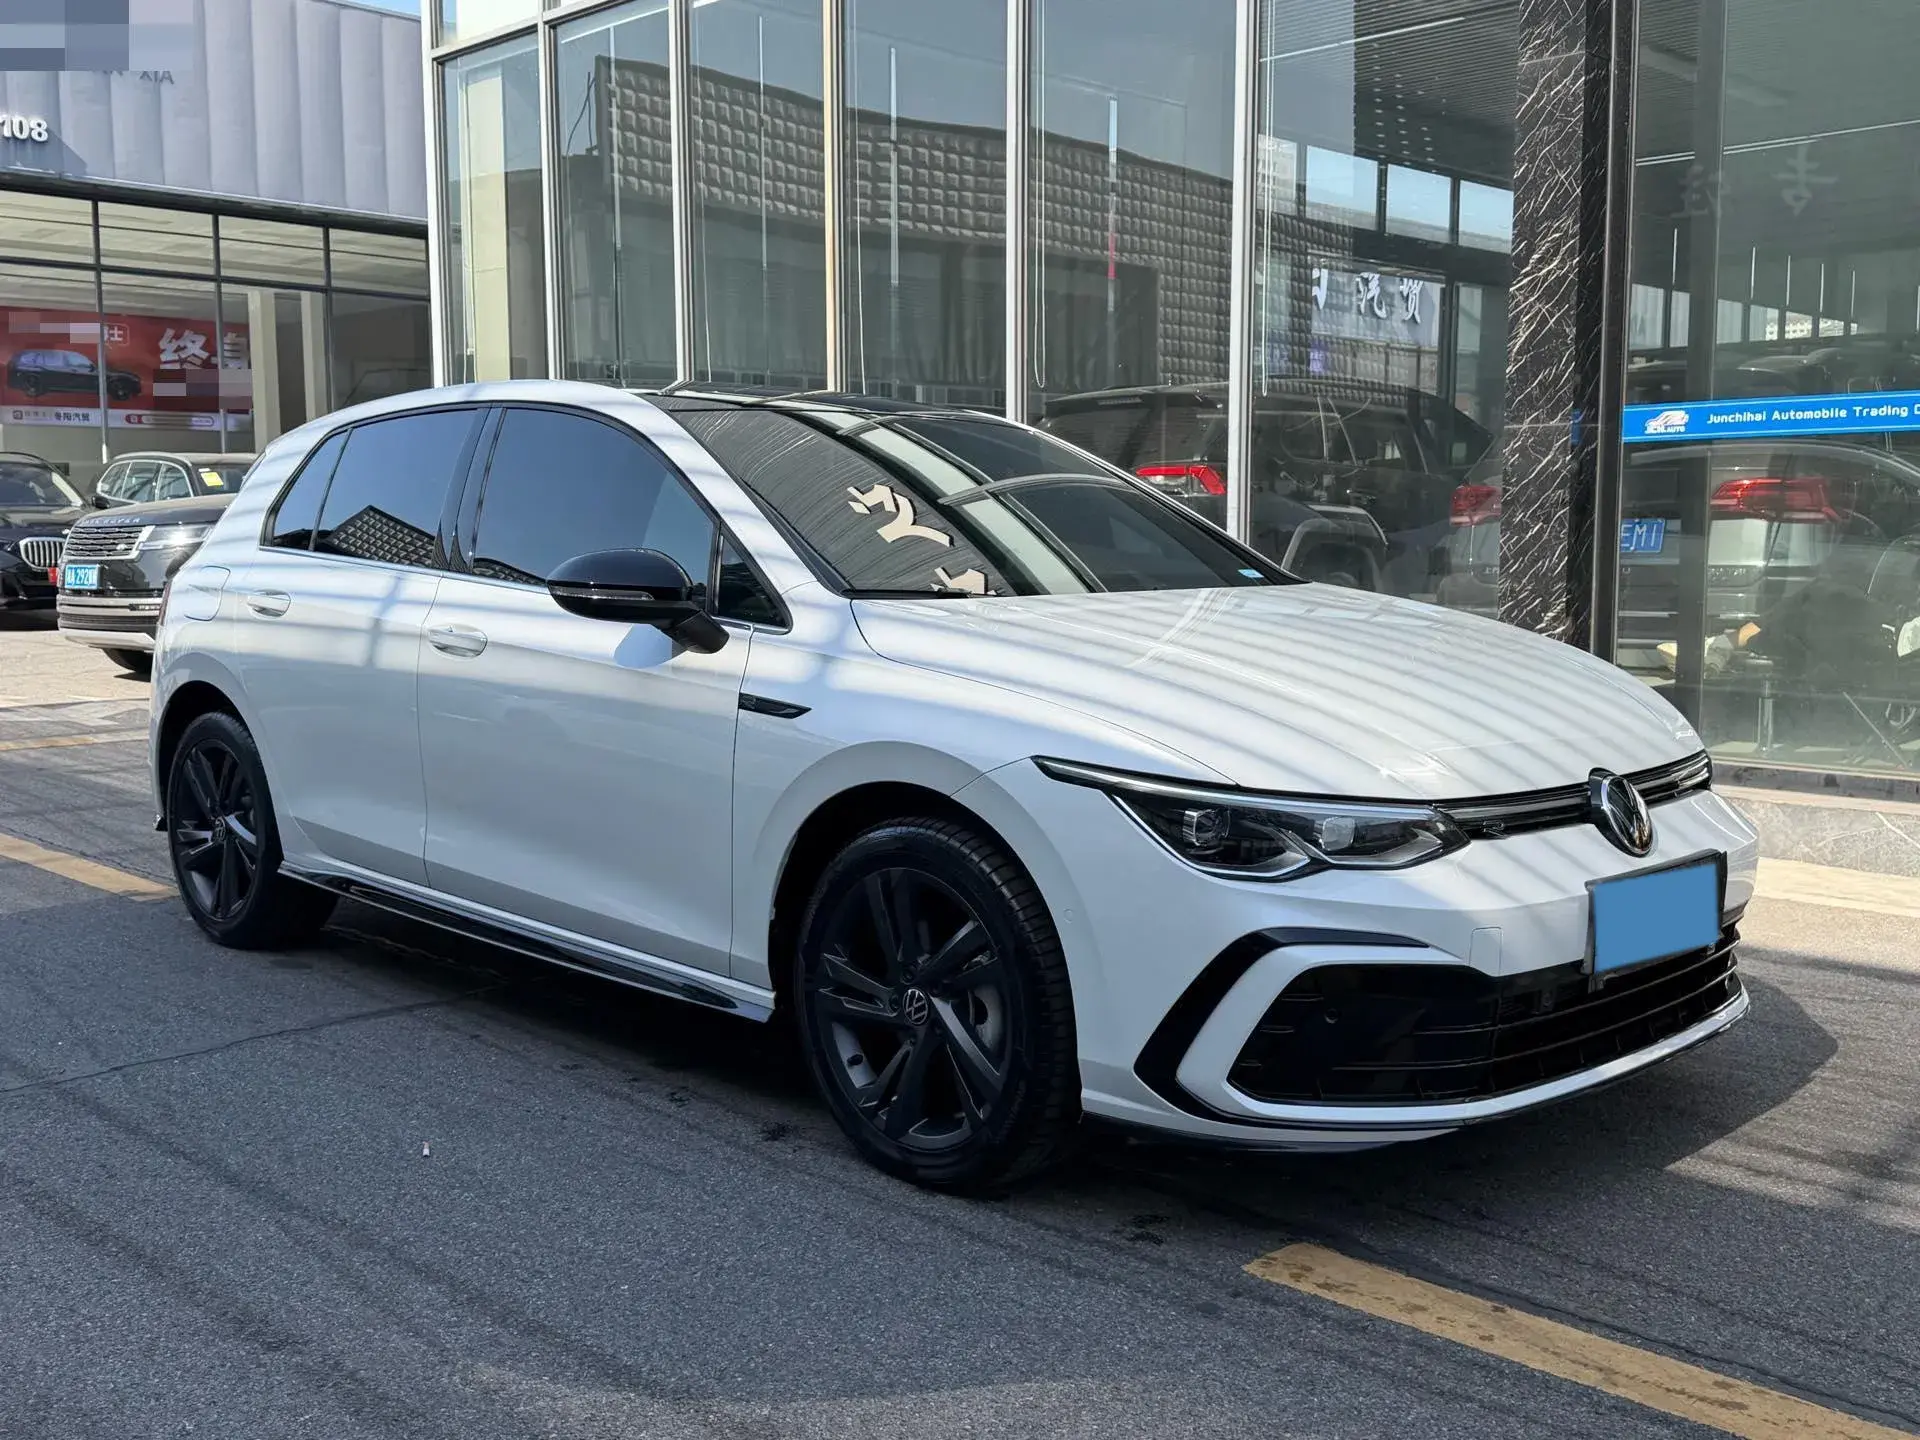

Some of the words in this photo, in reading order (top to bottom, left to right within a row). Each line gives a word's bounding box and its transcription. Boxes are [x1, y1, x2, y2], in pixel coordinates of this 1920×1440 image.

[1707, 412, 1767, 424] Junchihai
[1772, 408, 1847, 421] Automobile
[1853, 405, 1909, 418] Trading
